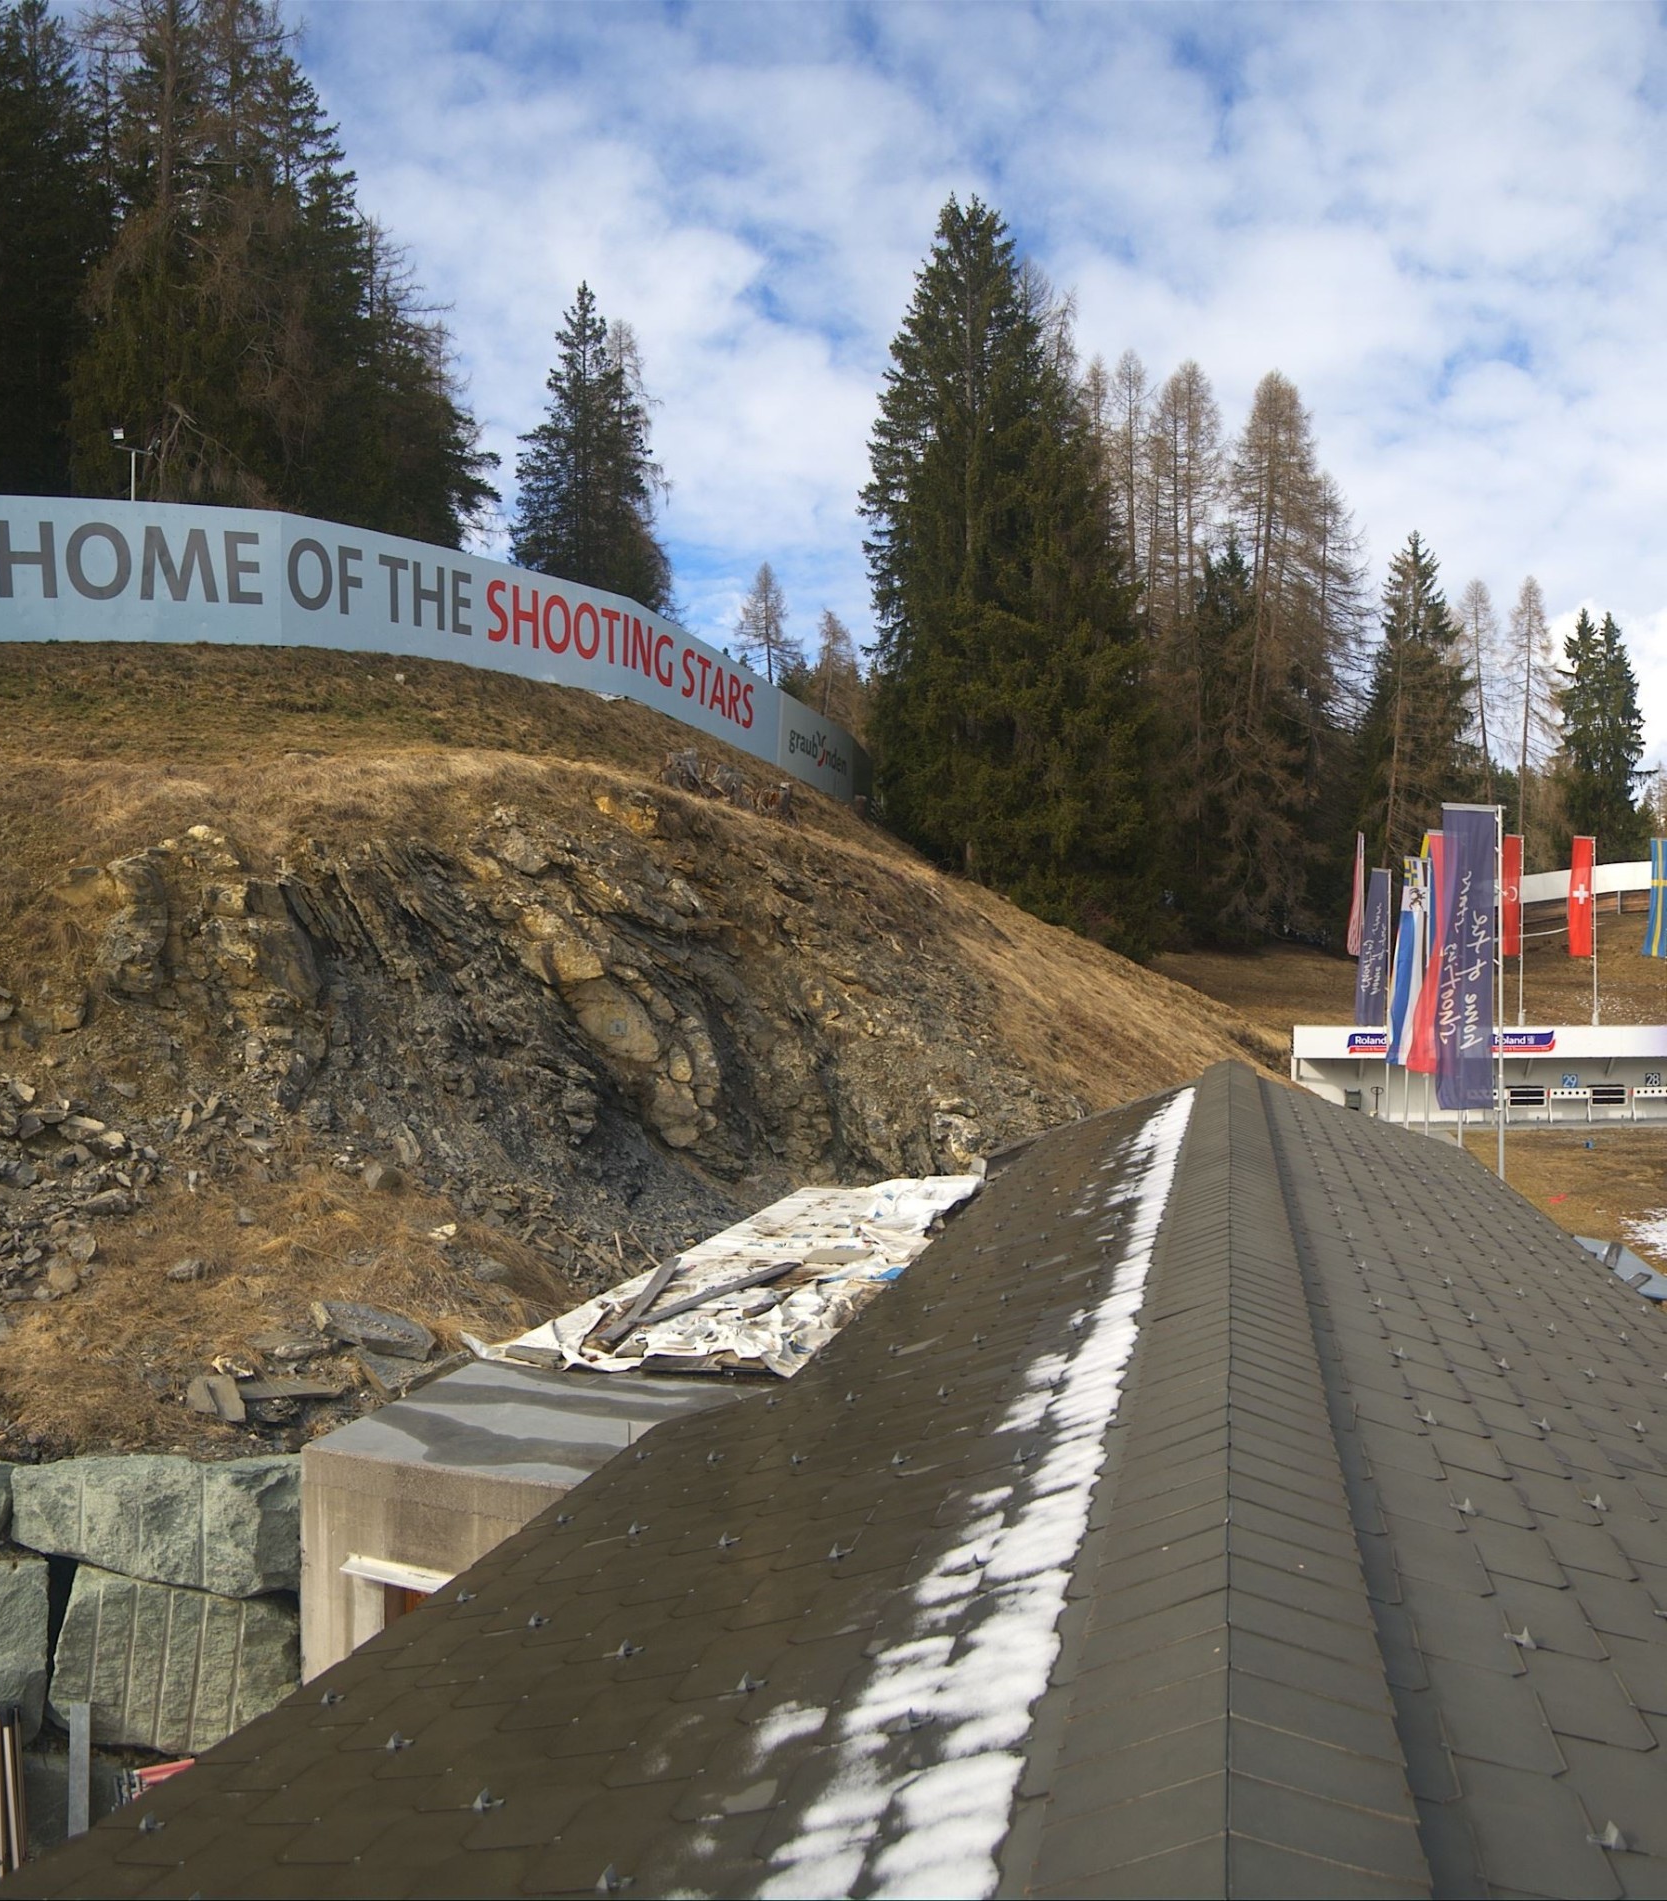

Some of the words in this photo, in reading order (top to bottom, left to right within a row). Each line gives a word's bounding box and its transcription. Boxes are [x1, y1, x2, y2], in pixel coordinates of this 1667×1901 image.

[287, 537, 363, 615] OF
[378, 553, 473, 636] THE
[486, 579, 674, 688] SHOOTING
[681, 648, 754, 729] STARS
[1355, 1036, 1387, 1045] Roland
[1563, 1076, 1577, 1088] 29
[1646, 1074, 1660, 1086] 28
